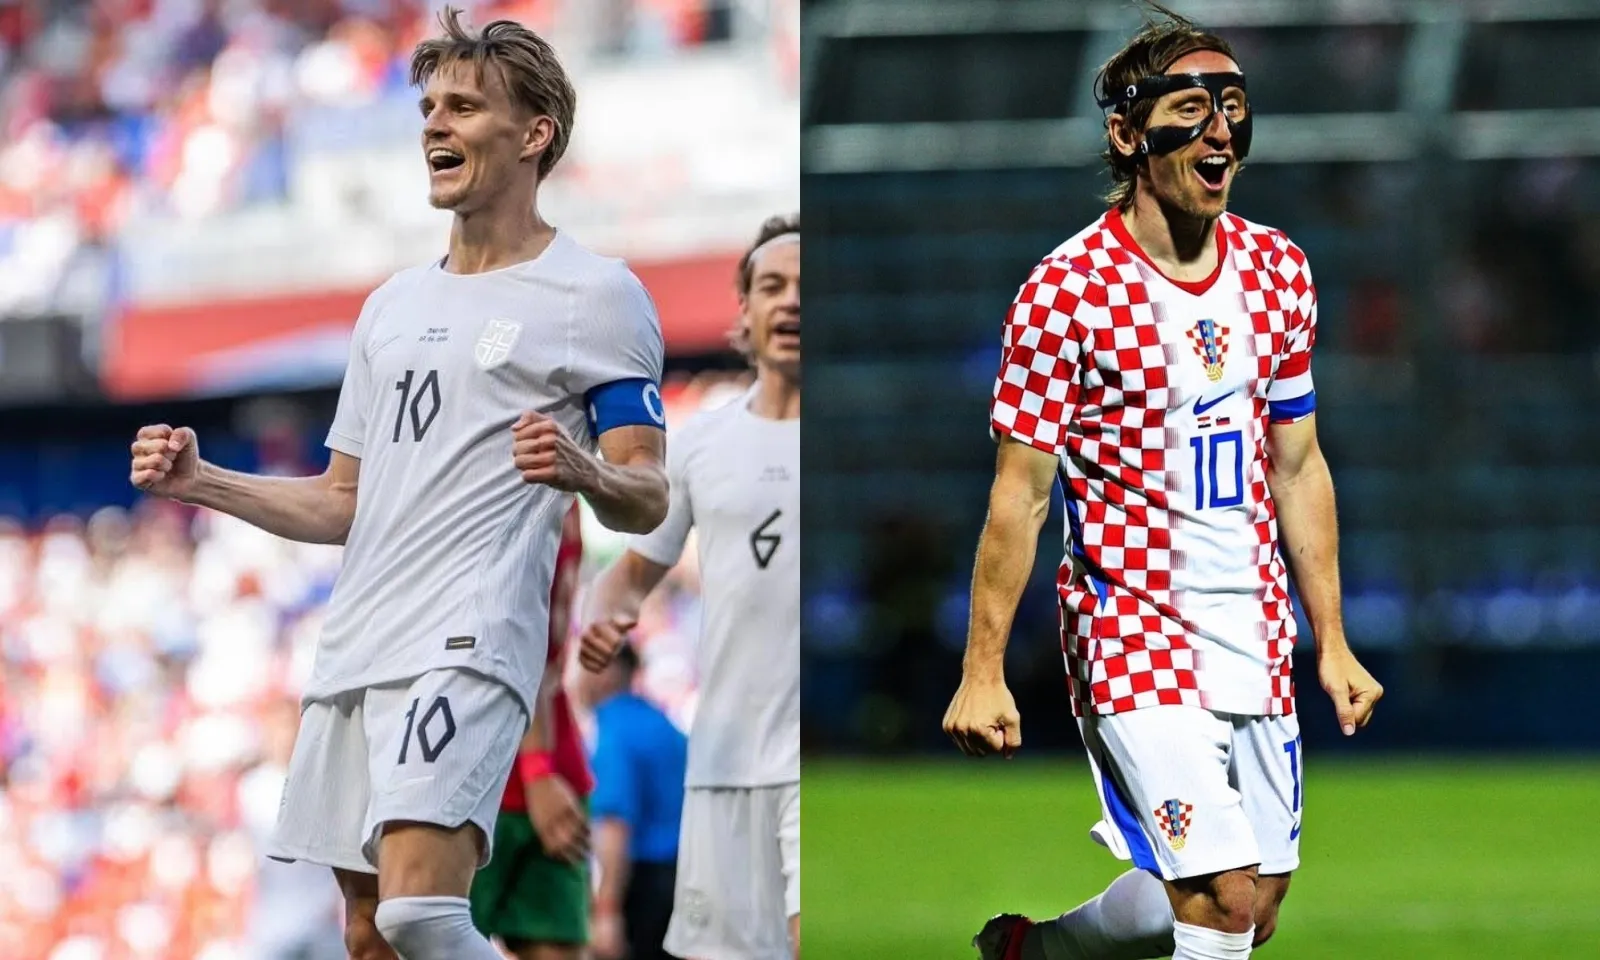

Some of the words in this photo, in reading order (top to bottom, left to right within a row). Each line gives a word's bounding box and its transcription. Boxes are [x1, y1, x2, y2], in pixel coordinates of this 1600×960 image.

[392, 369, 442, 443] 10
[642, 383, 665, 425] C
[1190, 430, 1243, 511] 10
[750, 508, 782, 570] 6
[398, 695, 457, 764] 10
[1283, 735, 1303, 813] 1
